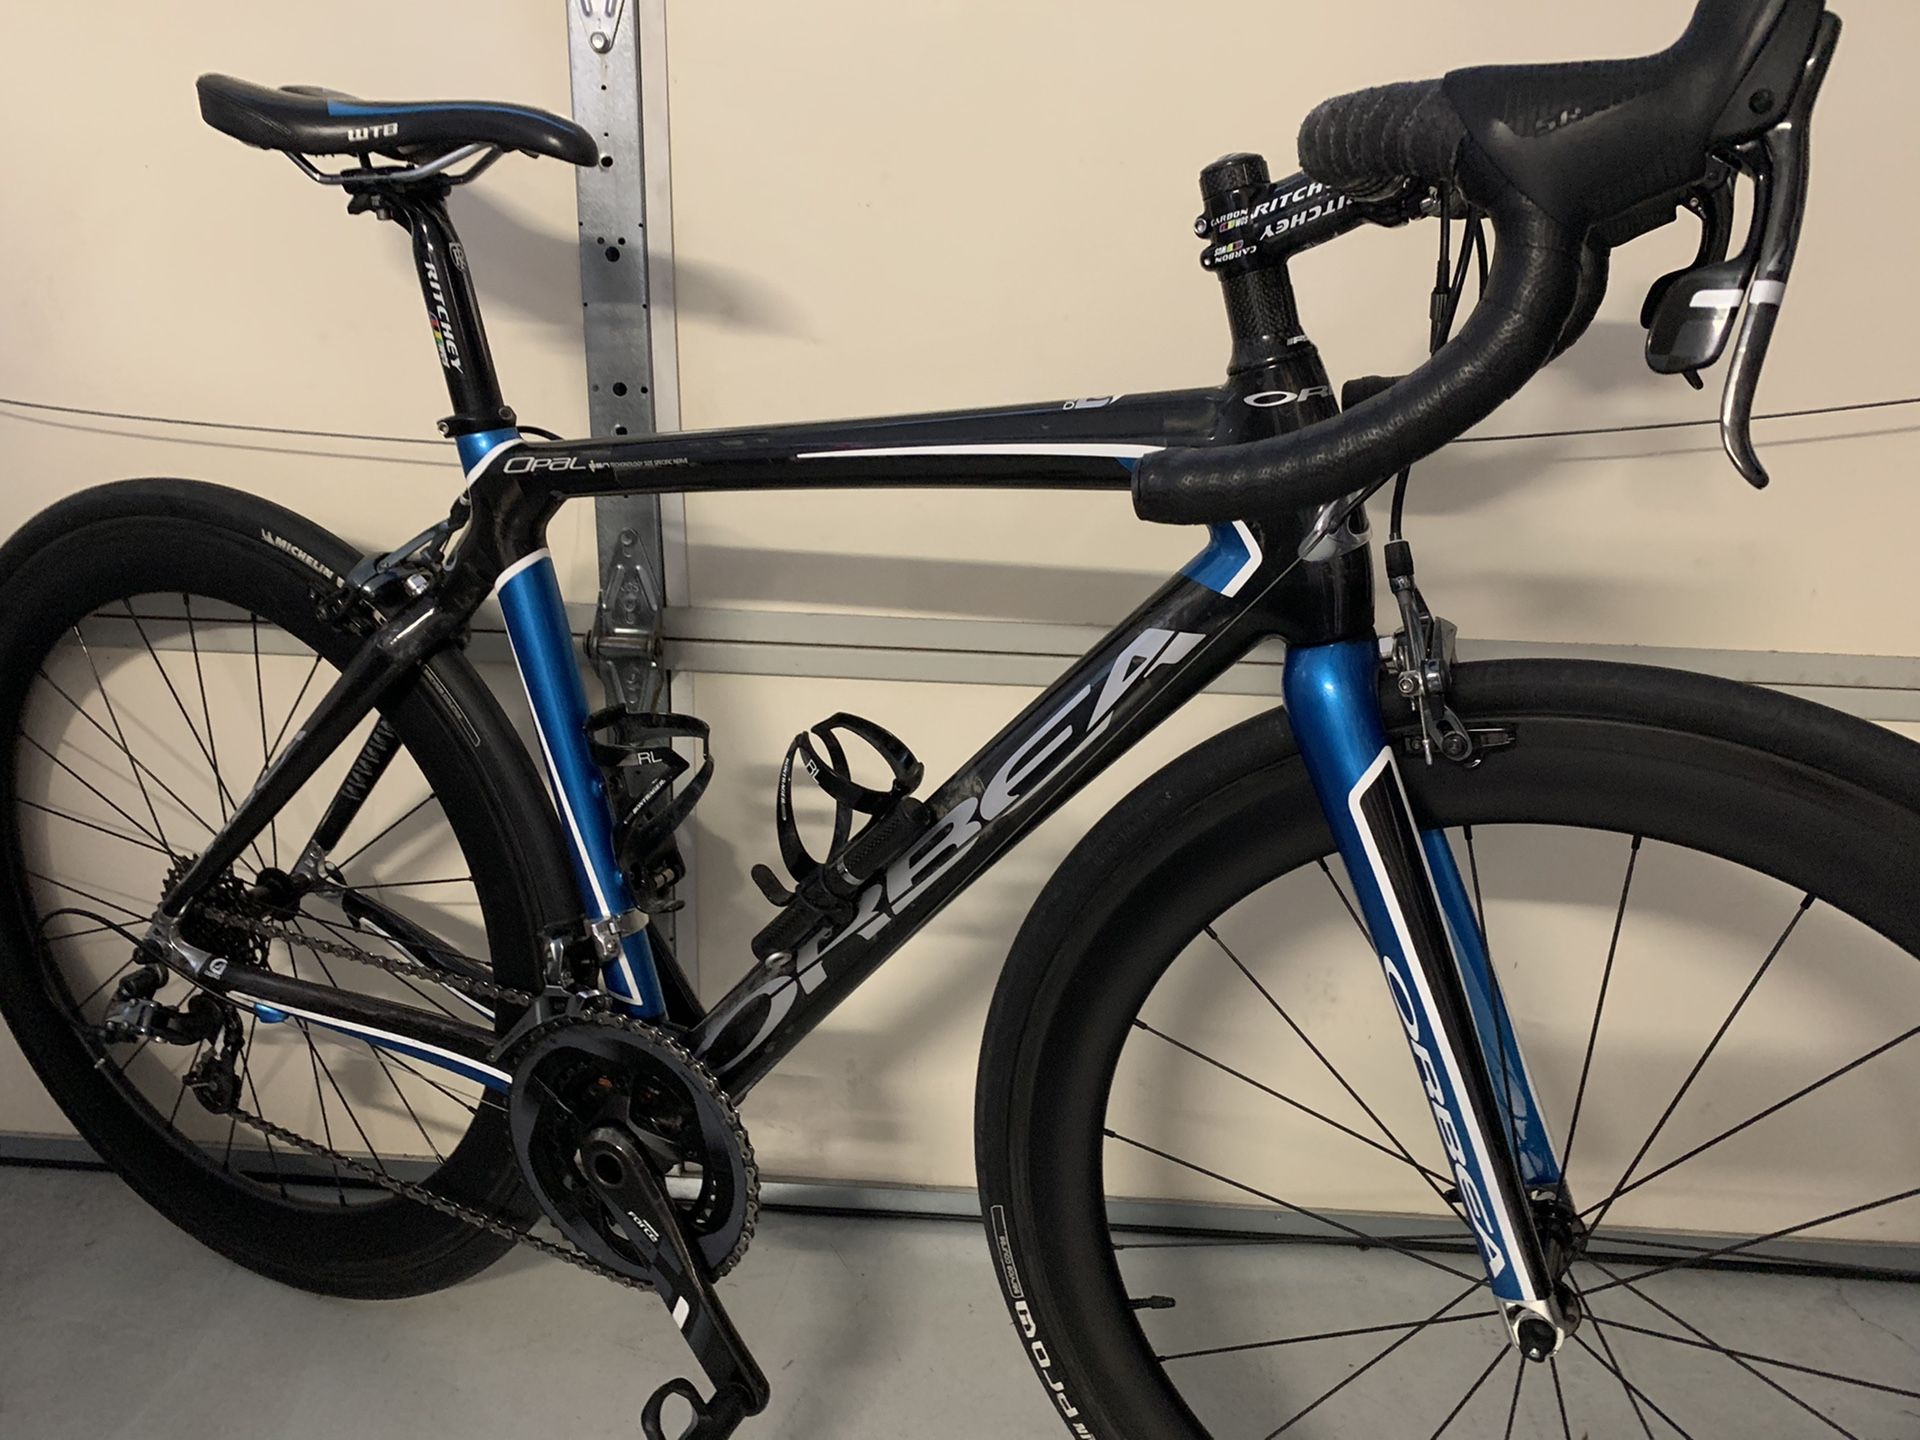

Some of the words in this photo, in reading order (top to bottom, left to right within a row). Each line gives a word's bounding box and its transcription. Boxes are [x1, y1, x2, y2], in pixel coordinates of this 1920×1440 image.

[347, 122, 399, 142] WTB
[1211, 208, 1249, 227] CARBON
[1251, 182, 1331, 220] RITCH
[1259, 195, 1353, 241] ITCHEY
[1214, 245, 1257, 264] CARBON
[424, 261, 463, 375] RITCHEY
[275, 536, 334, 580] MICHELIN
[637, 751, 662, 765] RL
[806, 759, 819, 784] RL
[699, 628, 1206, 1075] ORBEA
[1383, 955, 1506, 1279] ORBEA
